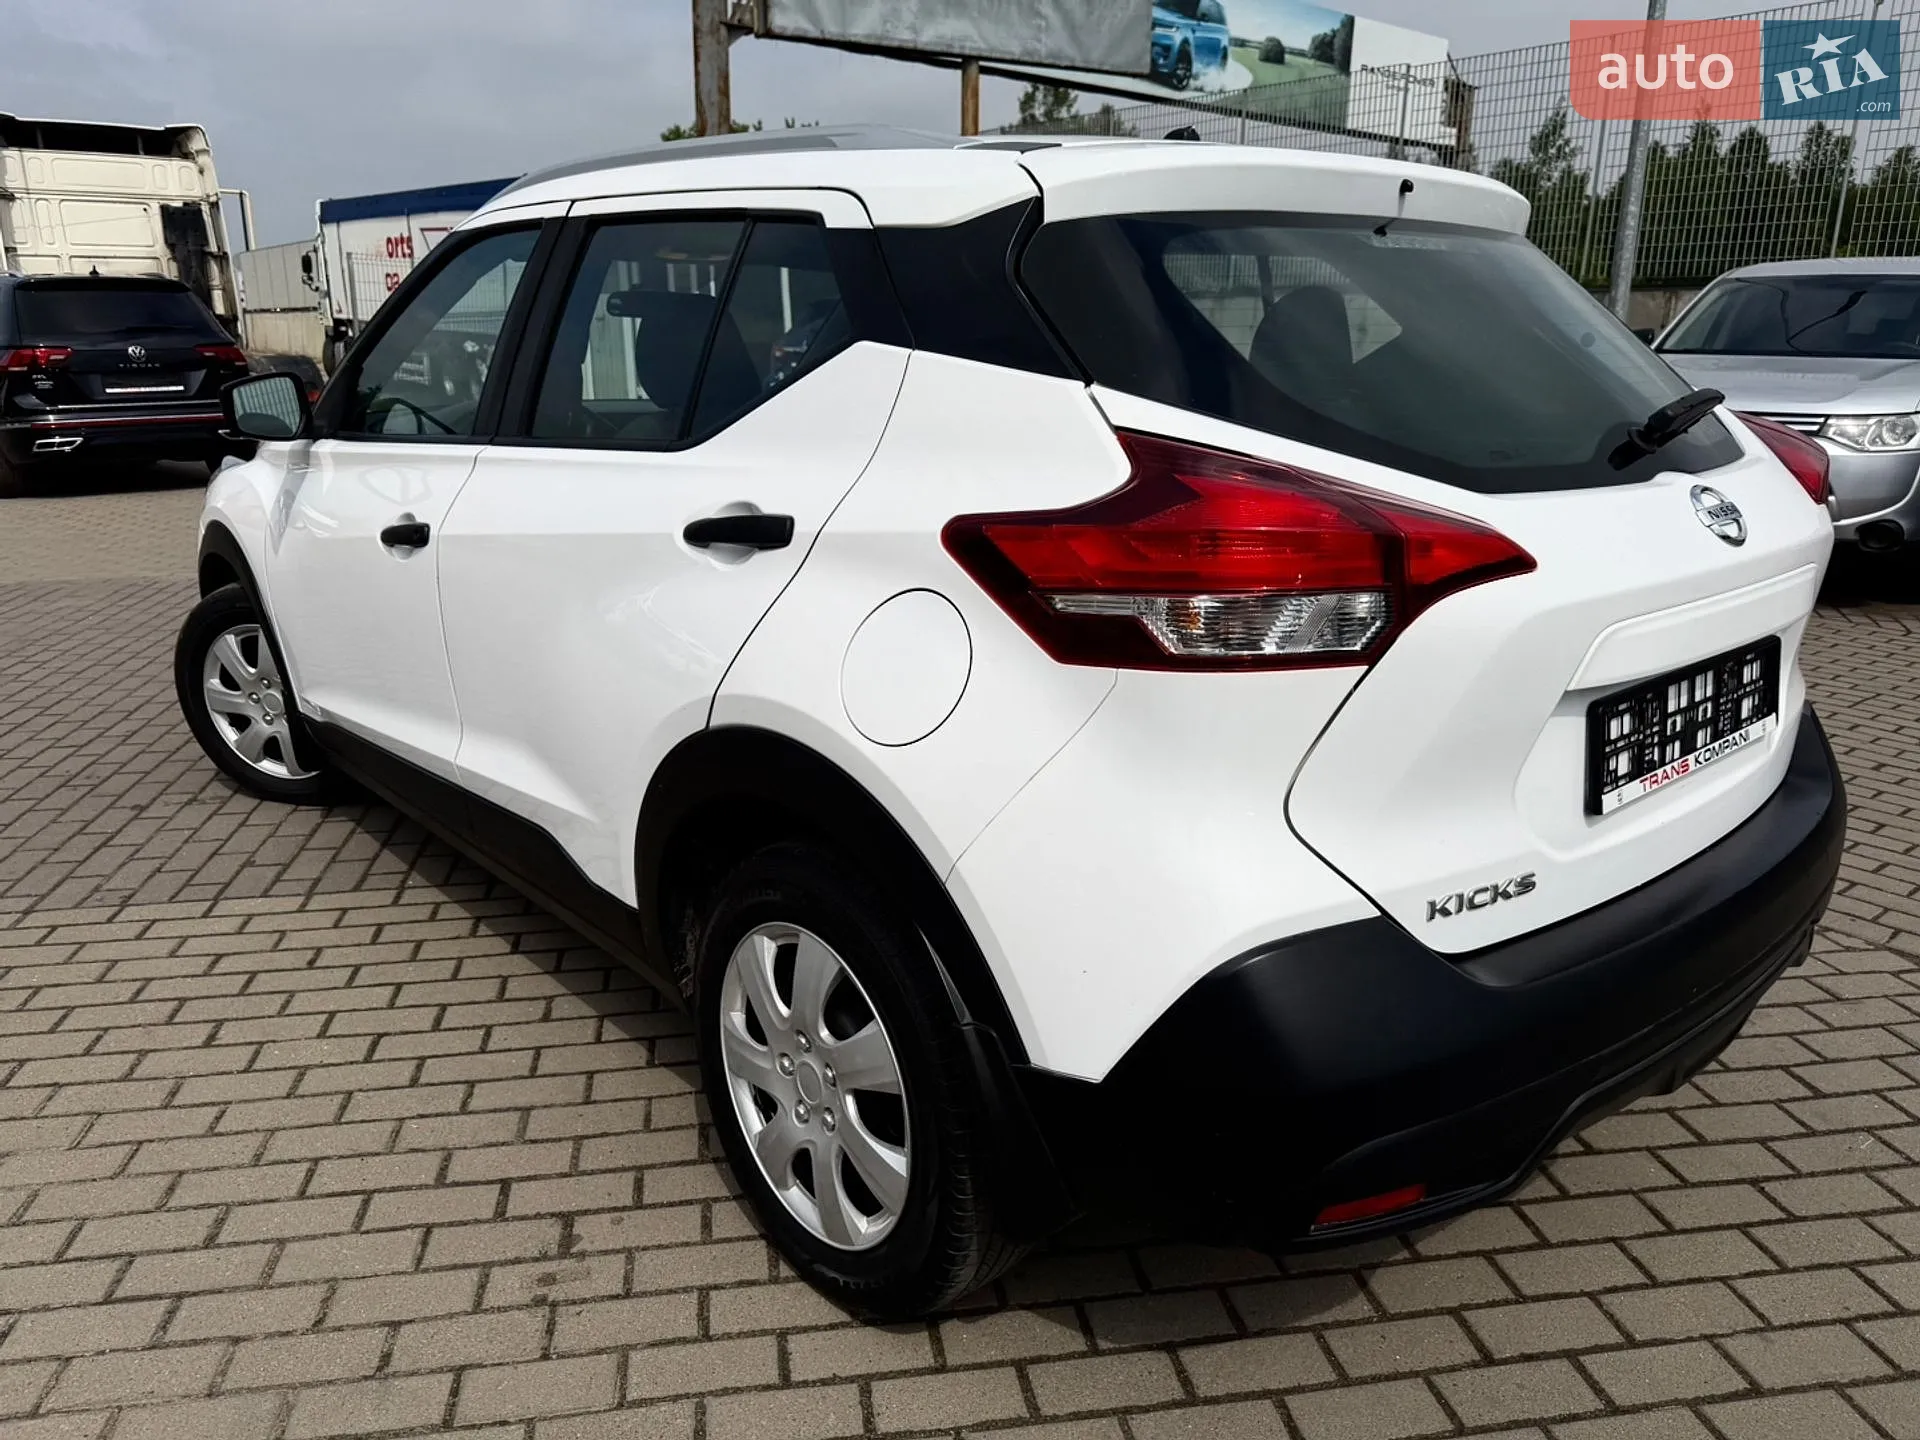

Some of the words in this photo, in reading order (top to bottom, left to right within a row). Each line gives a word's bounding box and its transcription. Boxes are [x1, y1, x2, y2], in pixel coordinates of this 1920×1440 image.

[1639, 757, 1690, 793] TRANS
[1694, 728, 1750, 768] KOMPANI
[1425, 871, 1537, 922] KICKS
